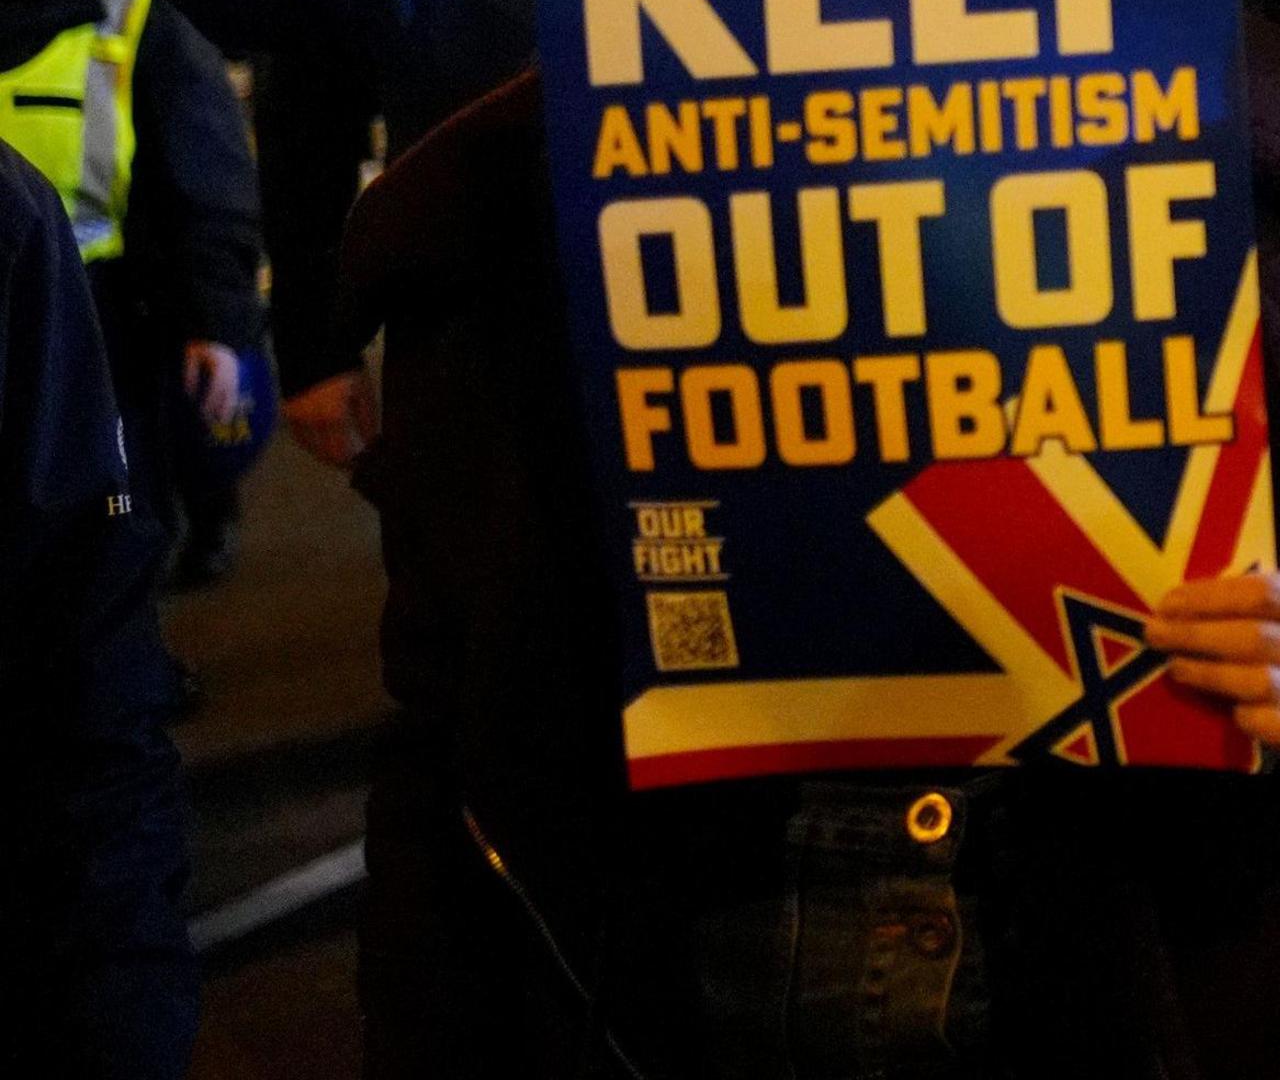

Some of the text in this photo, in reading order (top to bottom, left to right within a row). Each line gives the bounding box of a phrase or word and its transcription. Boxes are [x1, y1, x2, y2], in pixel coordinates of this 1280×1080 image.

[592, 65, 1201, 179] ANTI-SEMITISM
[598, 160, 1217, 351] OUT OF
[614, 335, 1234, 472] FOOTBALL
[632, 541, 723, 576] FIGHT
[637, 507, 707, 538] OUR
